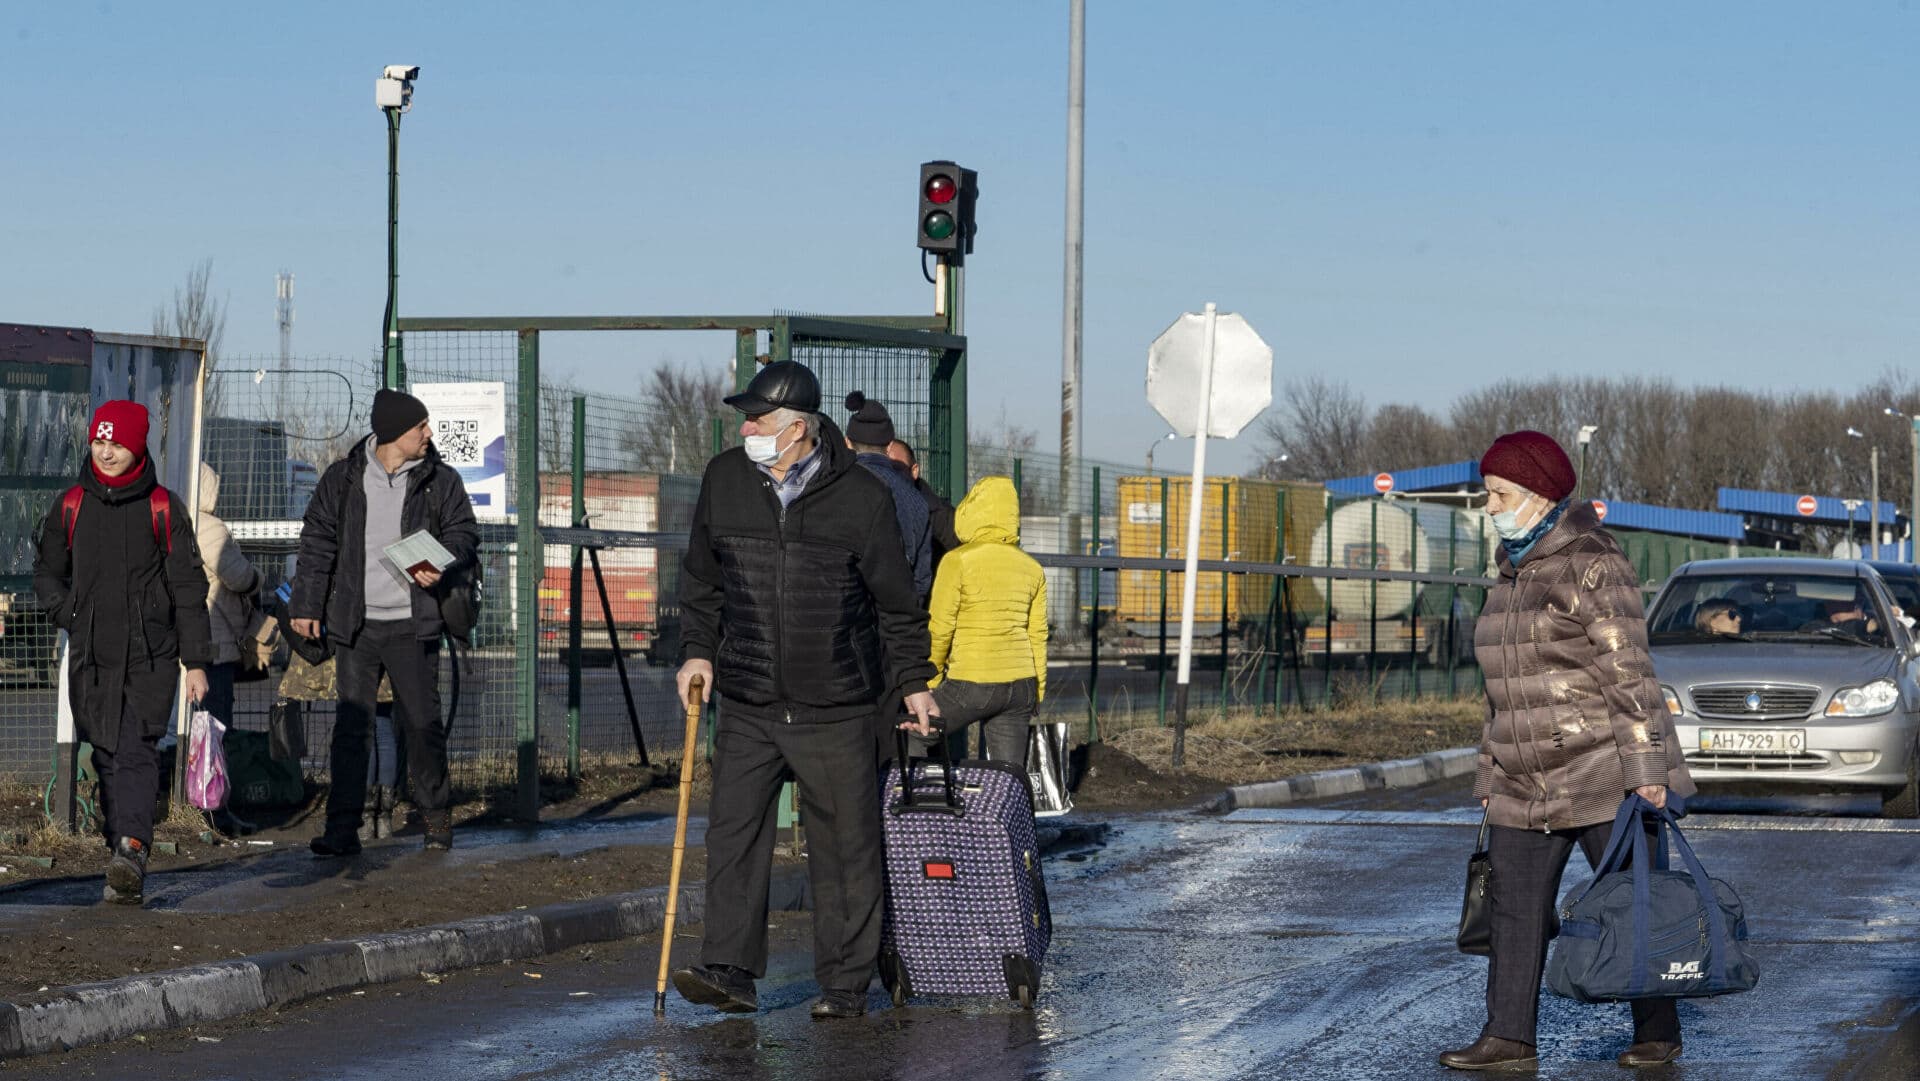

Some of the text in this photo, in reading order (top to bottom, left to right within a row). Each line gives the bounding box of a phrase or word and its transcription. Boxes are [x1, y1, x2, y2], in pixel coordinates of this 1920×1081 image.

[1711, 733, 1734, 748] AH
[1738, 734, 1774, 749] 7929
[1660, 972, 1704, 980] TRAFFIC
